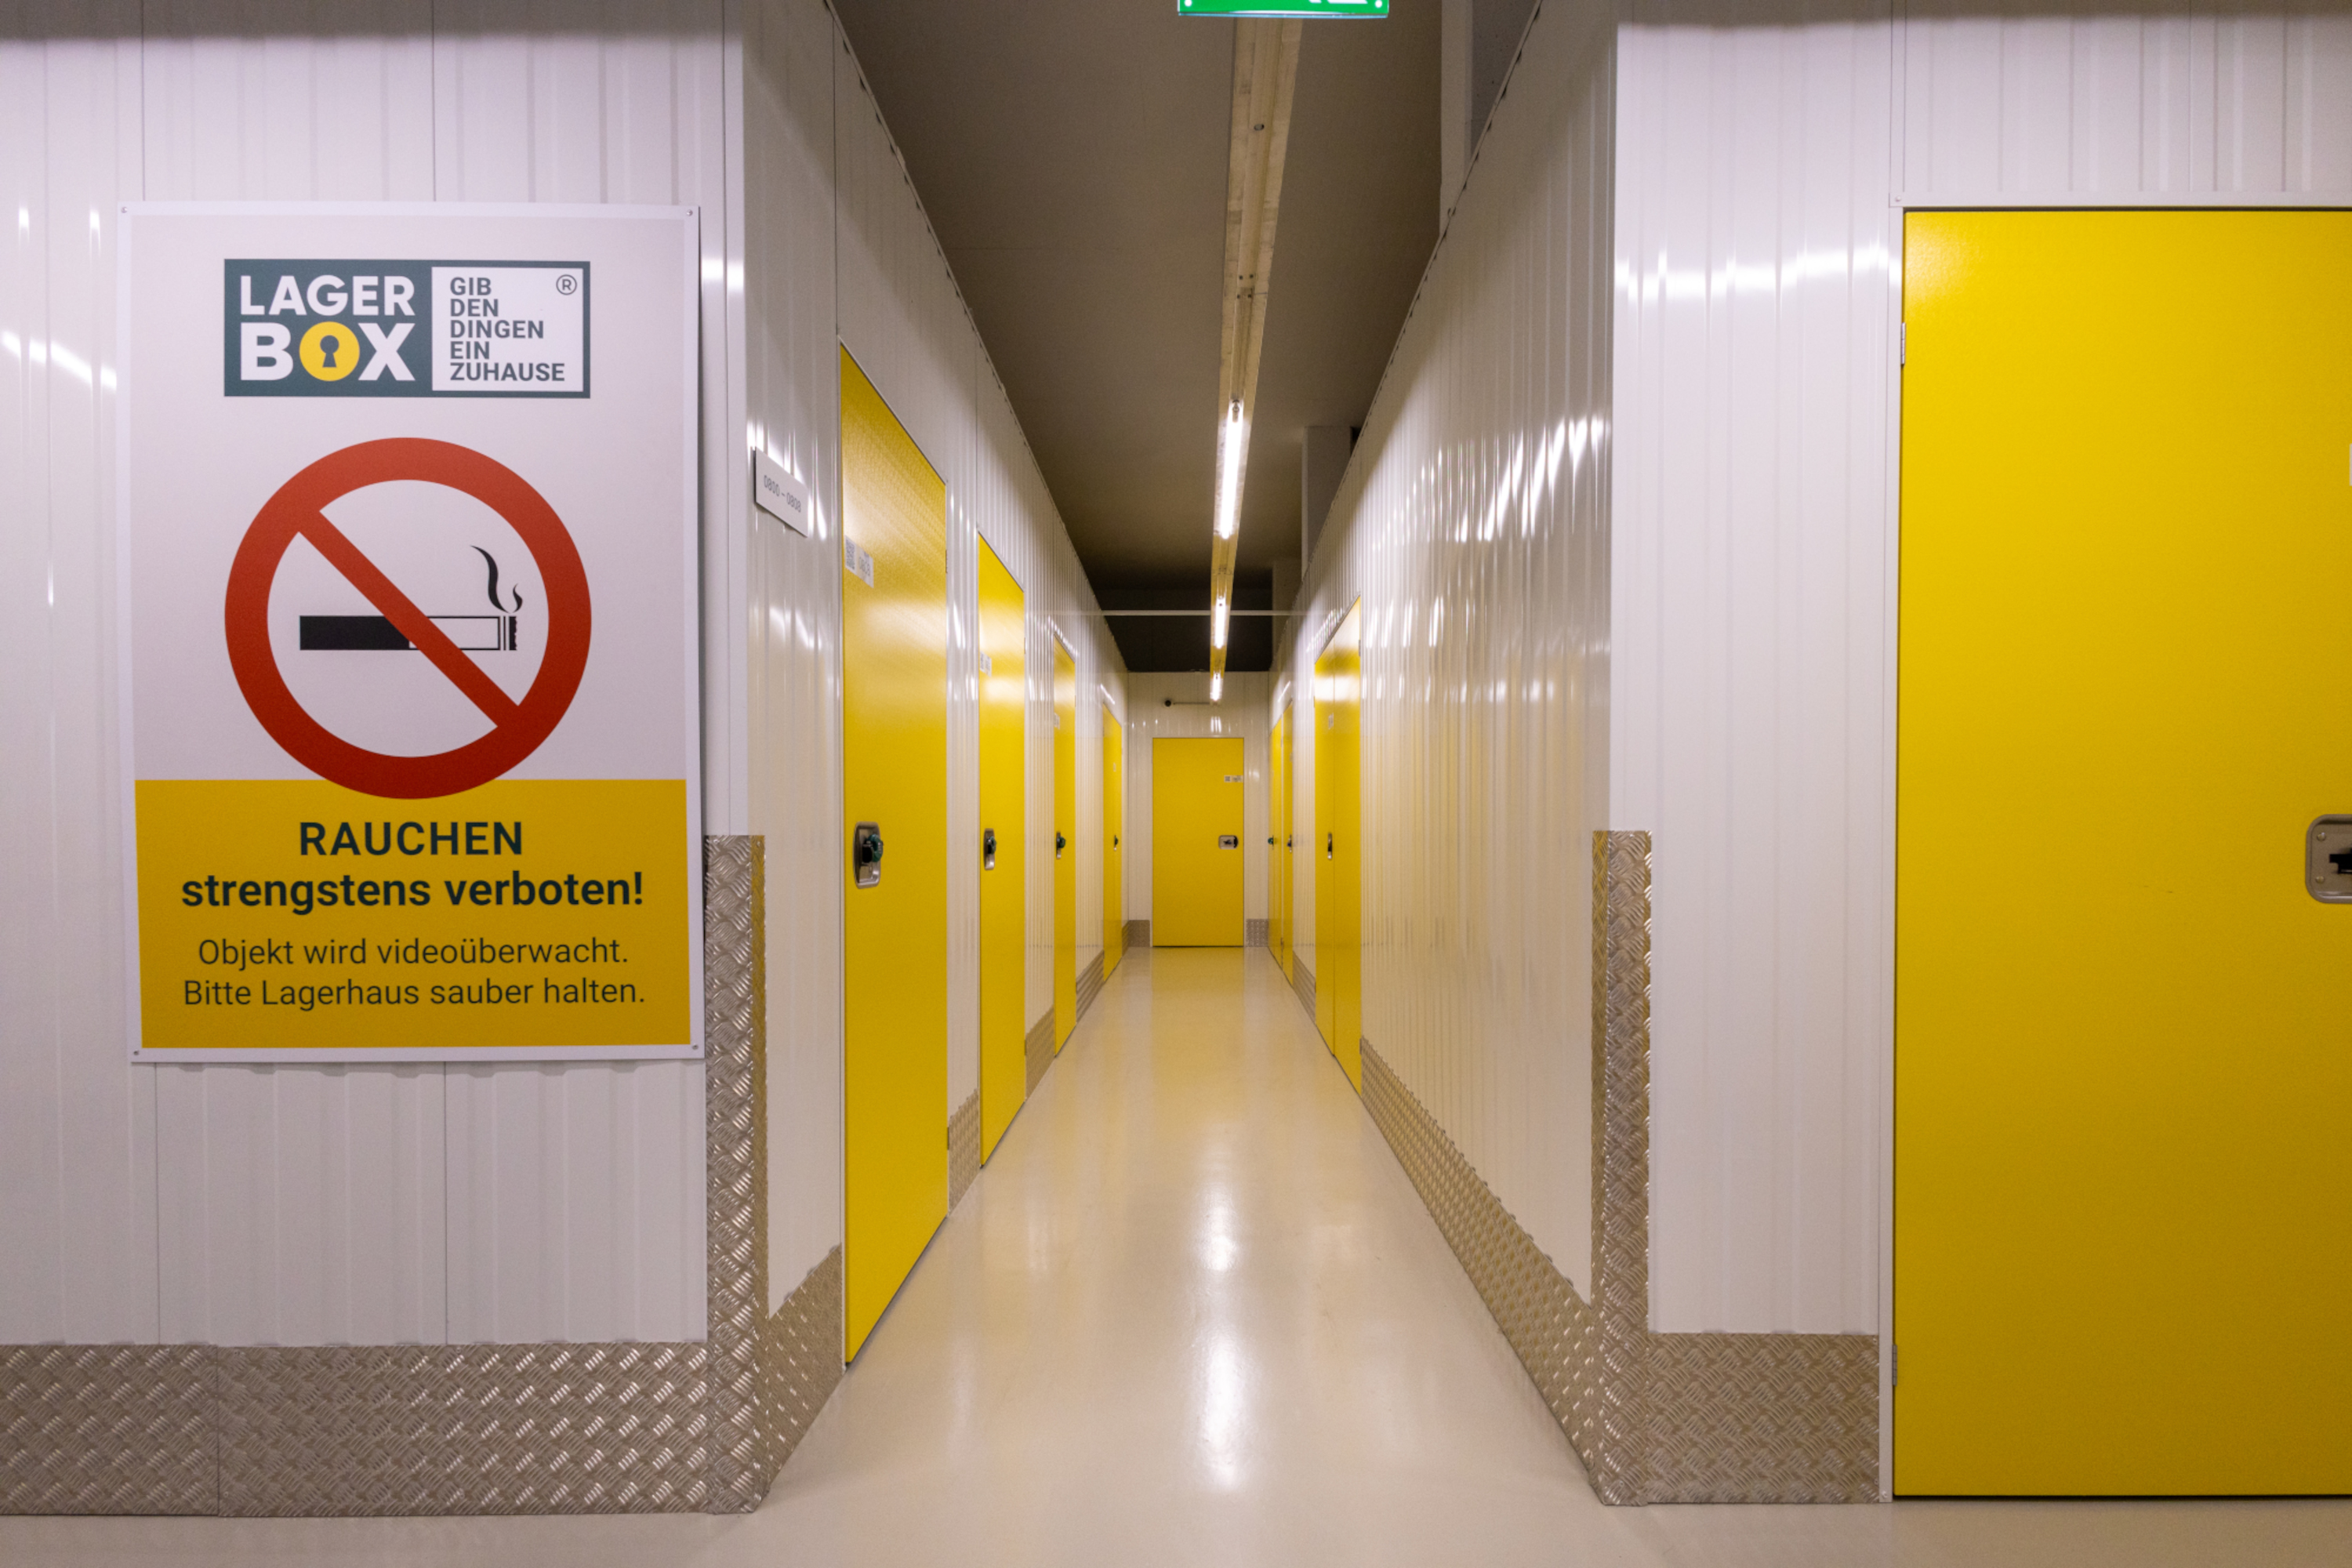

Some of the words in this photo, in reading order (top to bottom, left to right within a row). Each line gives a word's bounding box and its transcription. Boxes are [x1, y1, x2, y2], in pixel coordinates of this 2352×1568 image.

[240, 274, 416, 316] LAGER
[450, 277, 492, 296] GIB
[450, 298, 499, 318] DEN
[450, 319, 544, 339] DINGEN
[240, 321, 416, 382] BOX
[450, 340, 490, 360] EIN
[450, 362, 565, 382] ZUHAUSE
[299, 821, 522, 856] RAUCHEN
[182, 874, 431, 916] strengstens
[444, 869, 643, 906] verboten!
[198, 938, 294, 972] Objekt
[303, 938, 366, 964] wird
[376, 936, 628, 964] videoüberwacht.
[184, 979, 252, 1005] Bitte
[262, 978, 419, 1012] Lagerhaus
[430, 978, 534, 1005] sauber
[544, 977, 644, 1004] halten.
